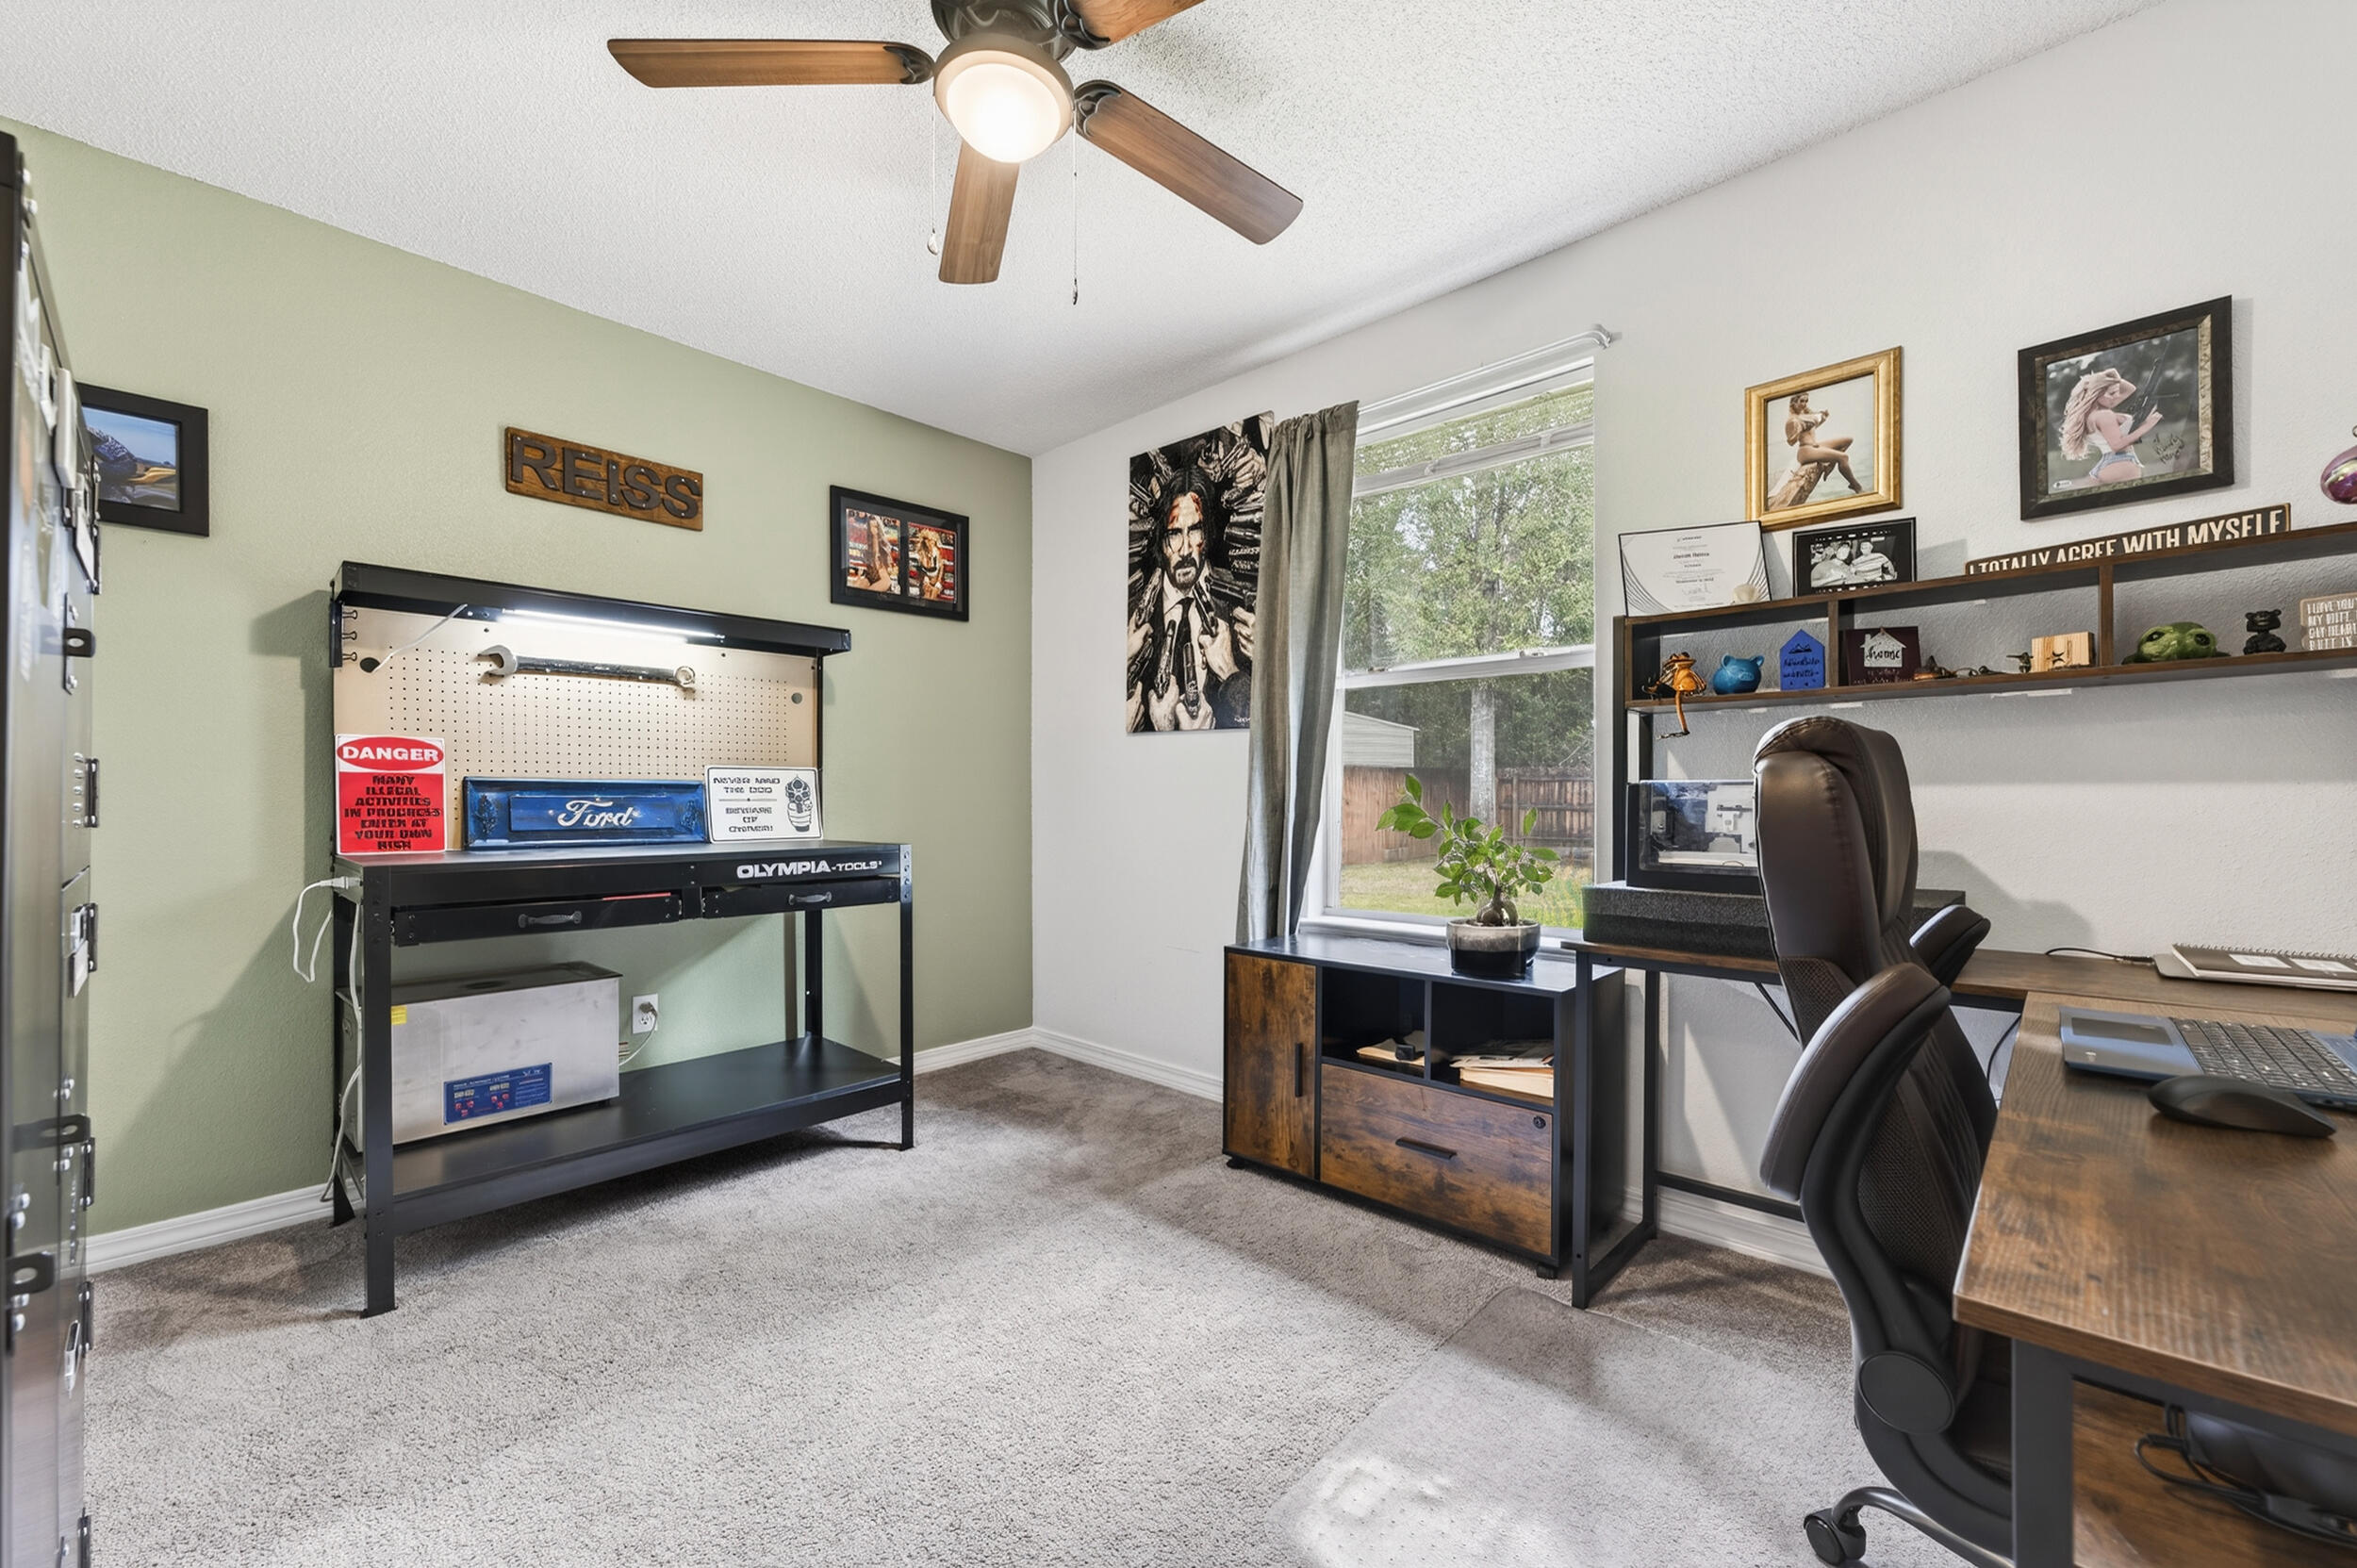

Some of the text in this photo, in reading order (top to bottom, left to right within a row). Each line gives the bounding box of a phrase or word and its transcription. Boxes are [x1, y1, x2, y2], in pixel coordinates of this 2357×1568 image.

[510, 433, 701, 520] REISS
[2121, 528, 2181, 554] WITH
[342, 746, 439, 762] DANGER
[372, 775, 415, 785] MANY
[366, 786, 421, 796] ILLEGAL
[355, 797, 431, 806] ACTIVITIES
[344, 808, 361, 817] IN
[557, 800, 634, 827] Ford
[411, 818, 428, 828] AT
[354, 829, 433, 839] YOUR OWN
